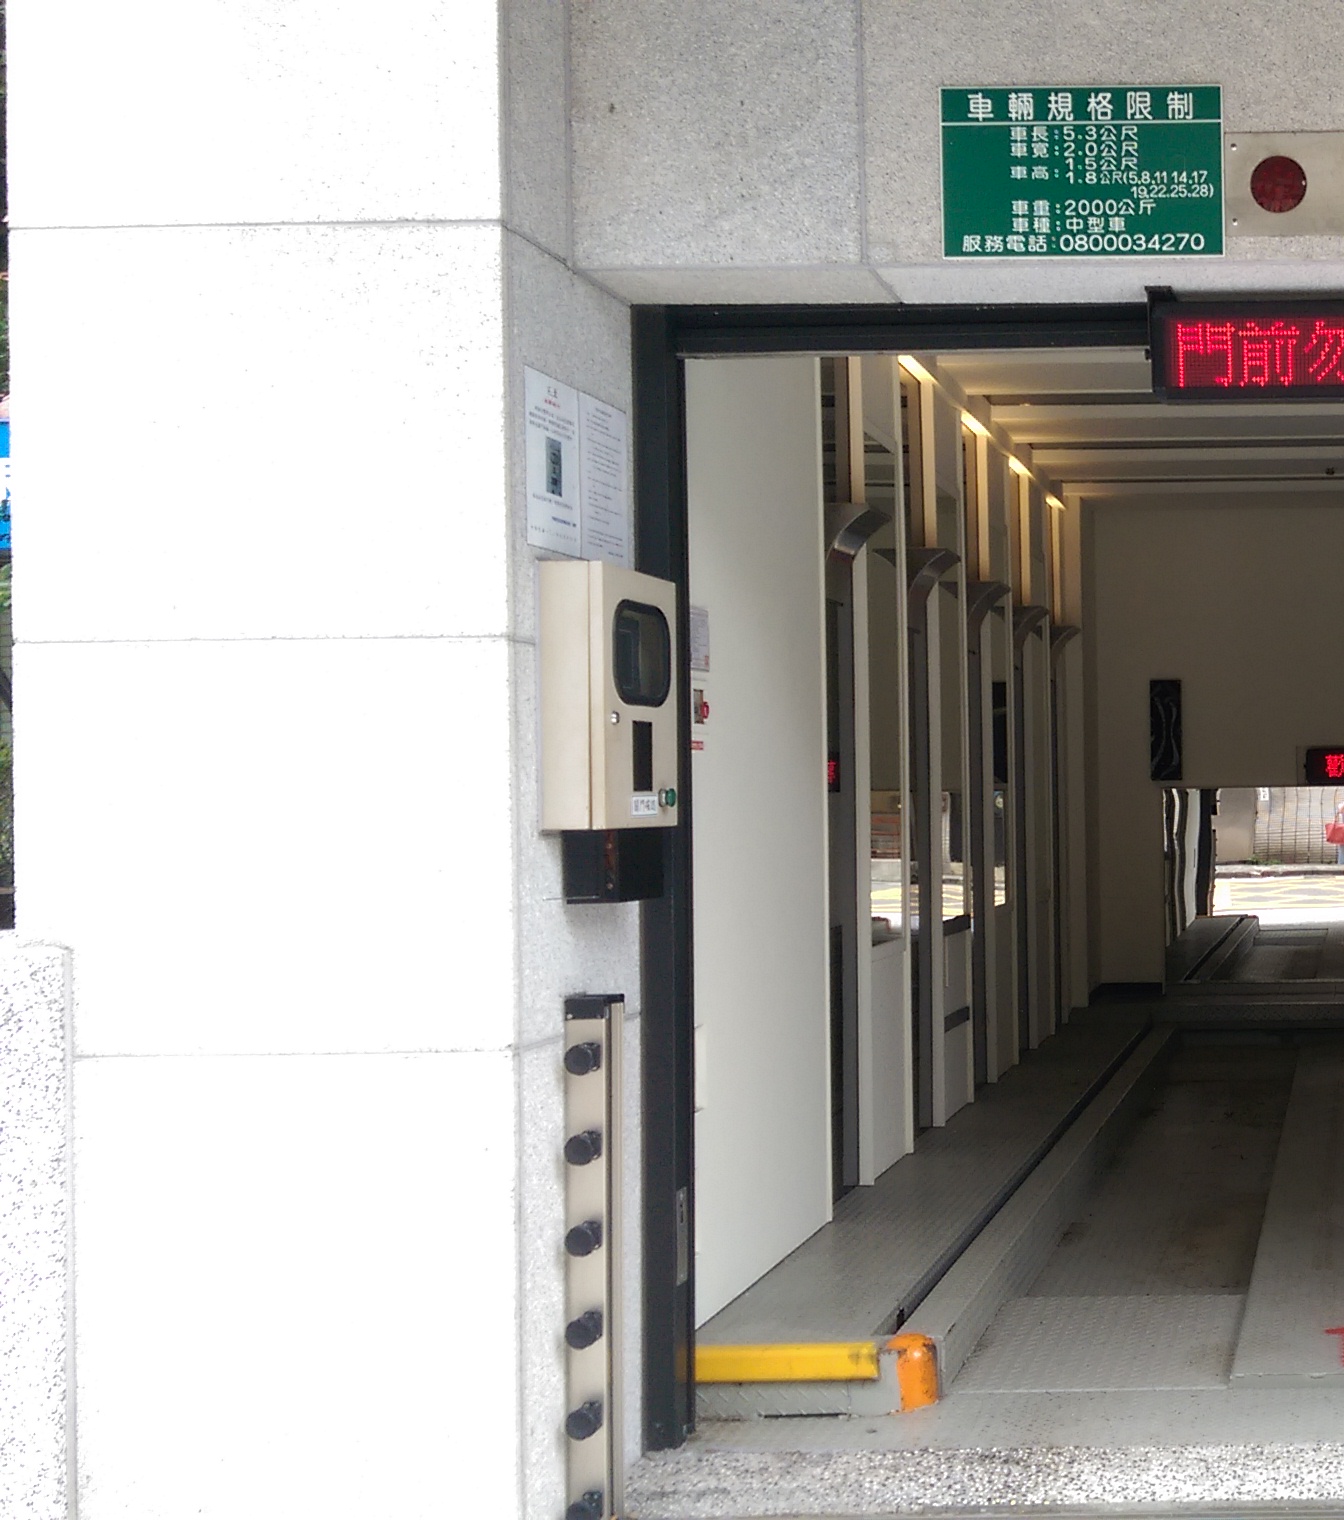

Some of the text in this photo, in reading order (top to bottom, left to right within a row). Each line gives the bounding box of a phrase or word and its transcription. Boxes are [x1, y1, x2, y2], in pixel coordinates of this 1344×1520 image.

[967, 91, 1193, 121] 車輛規格限制
